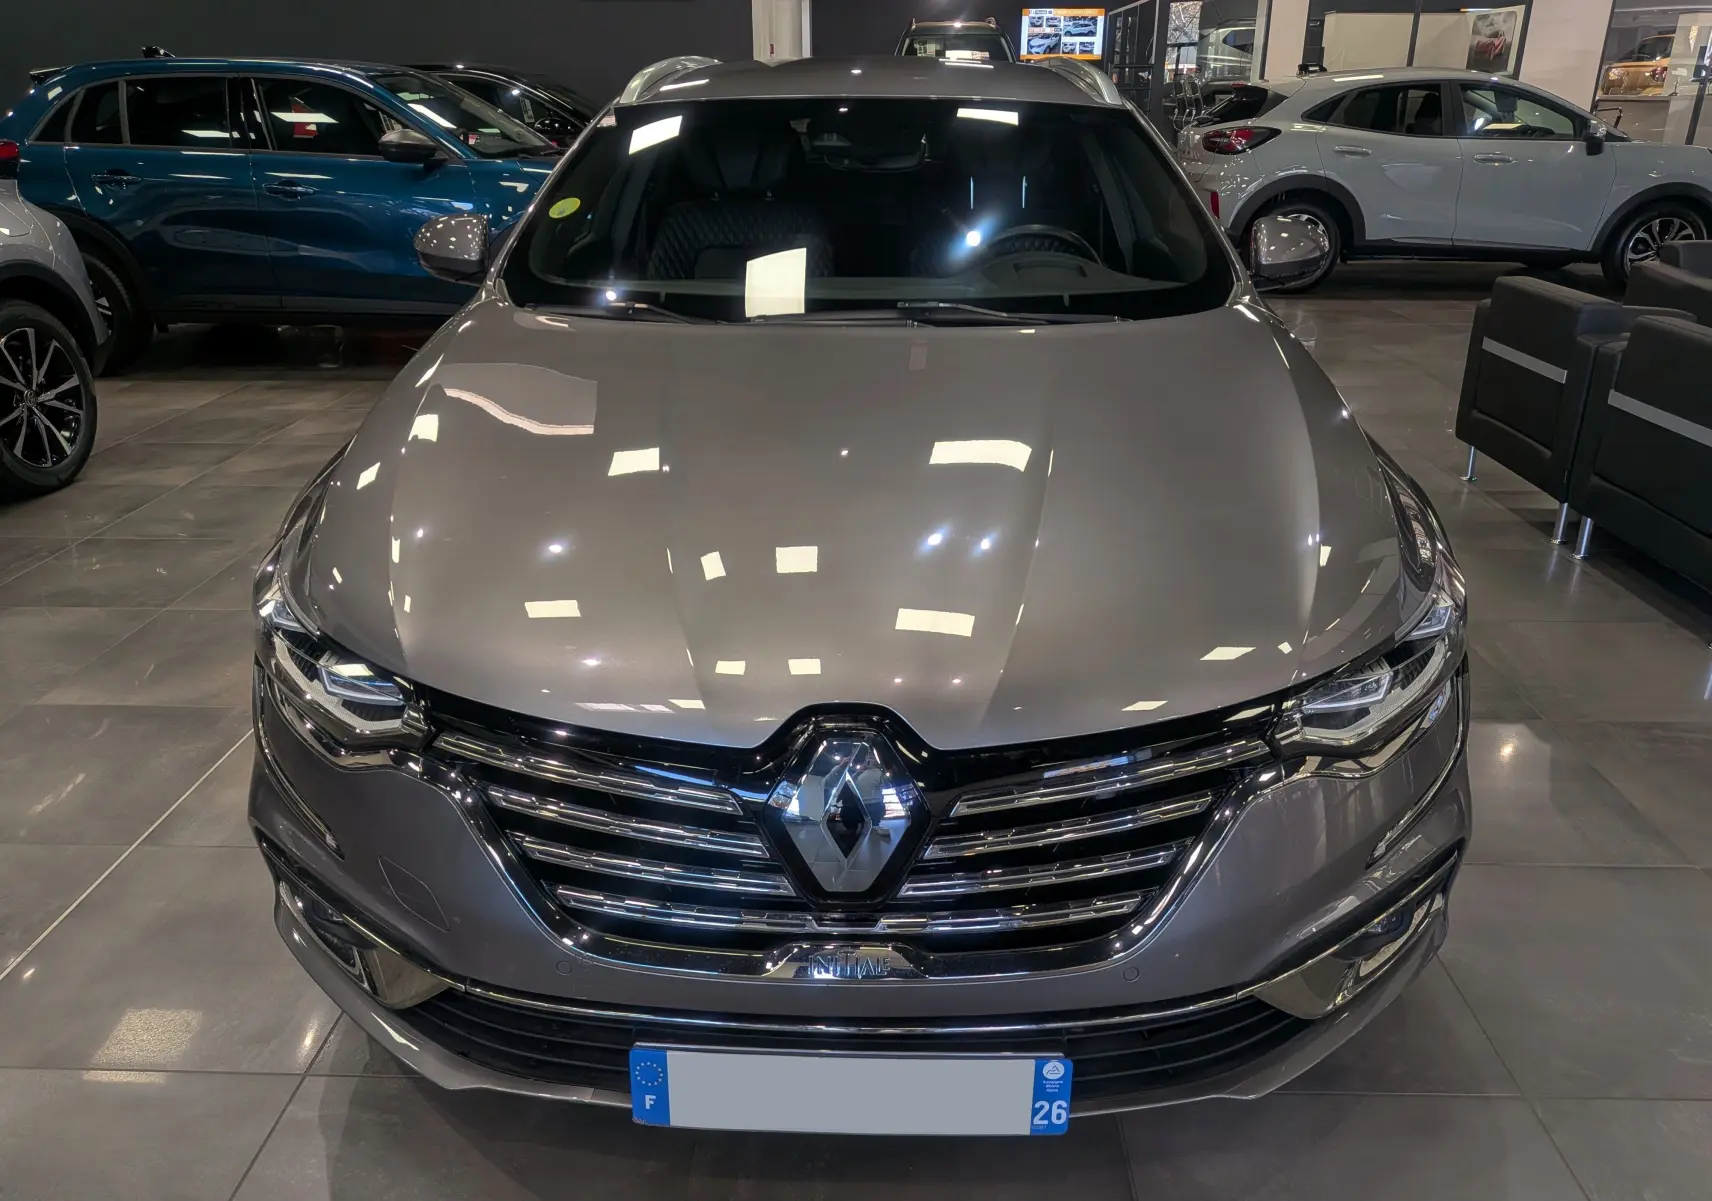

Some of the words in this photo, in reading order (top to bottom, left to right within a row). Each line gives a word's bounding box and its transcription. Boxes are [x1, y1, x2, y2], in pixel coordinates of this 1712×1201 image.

[808, 952, 891, 979] INITIALE
[645, 1094, 656, 1109] F
[1033, 1100, 1067, 1125] 26
